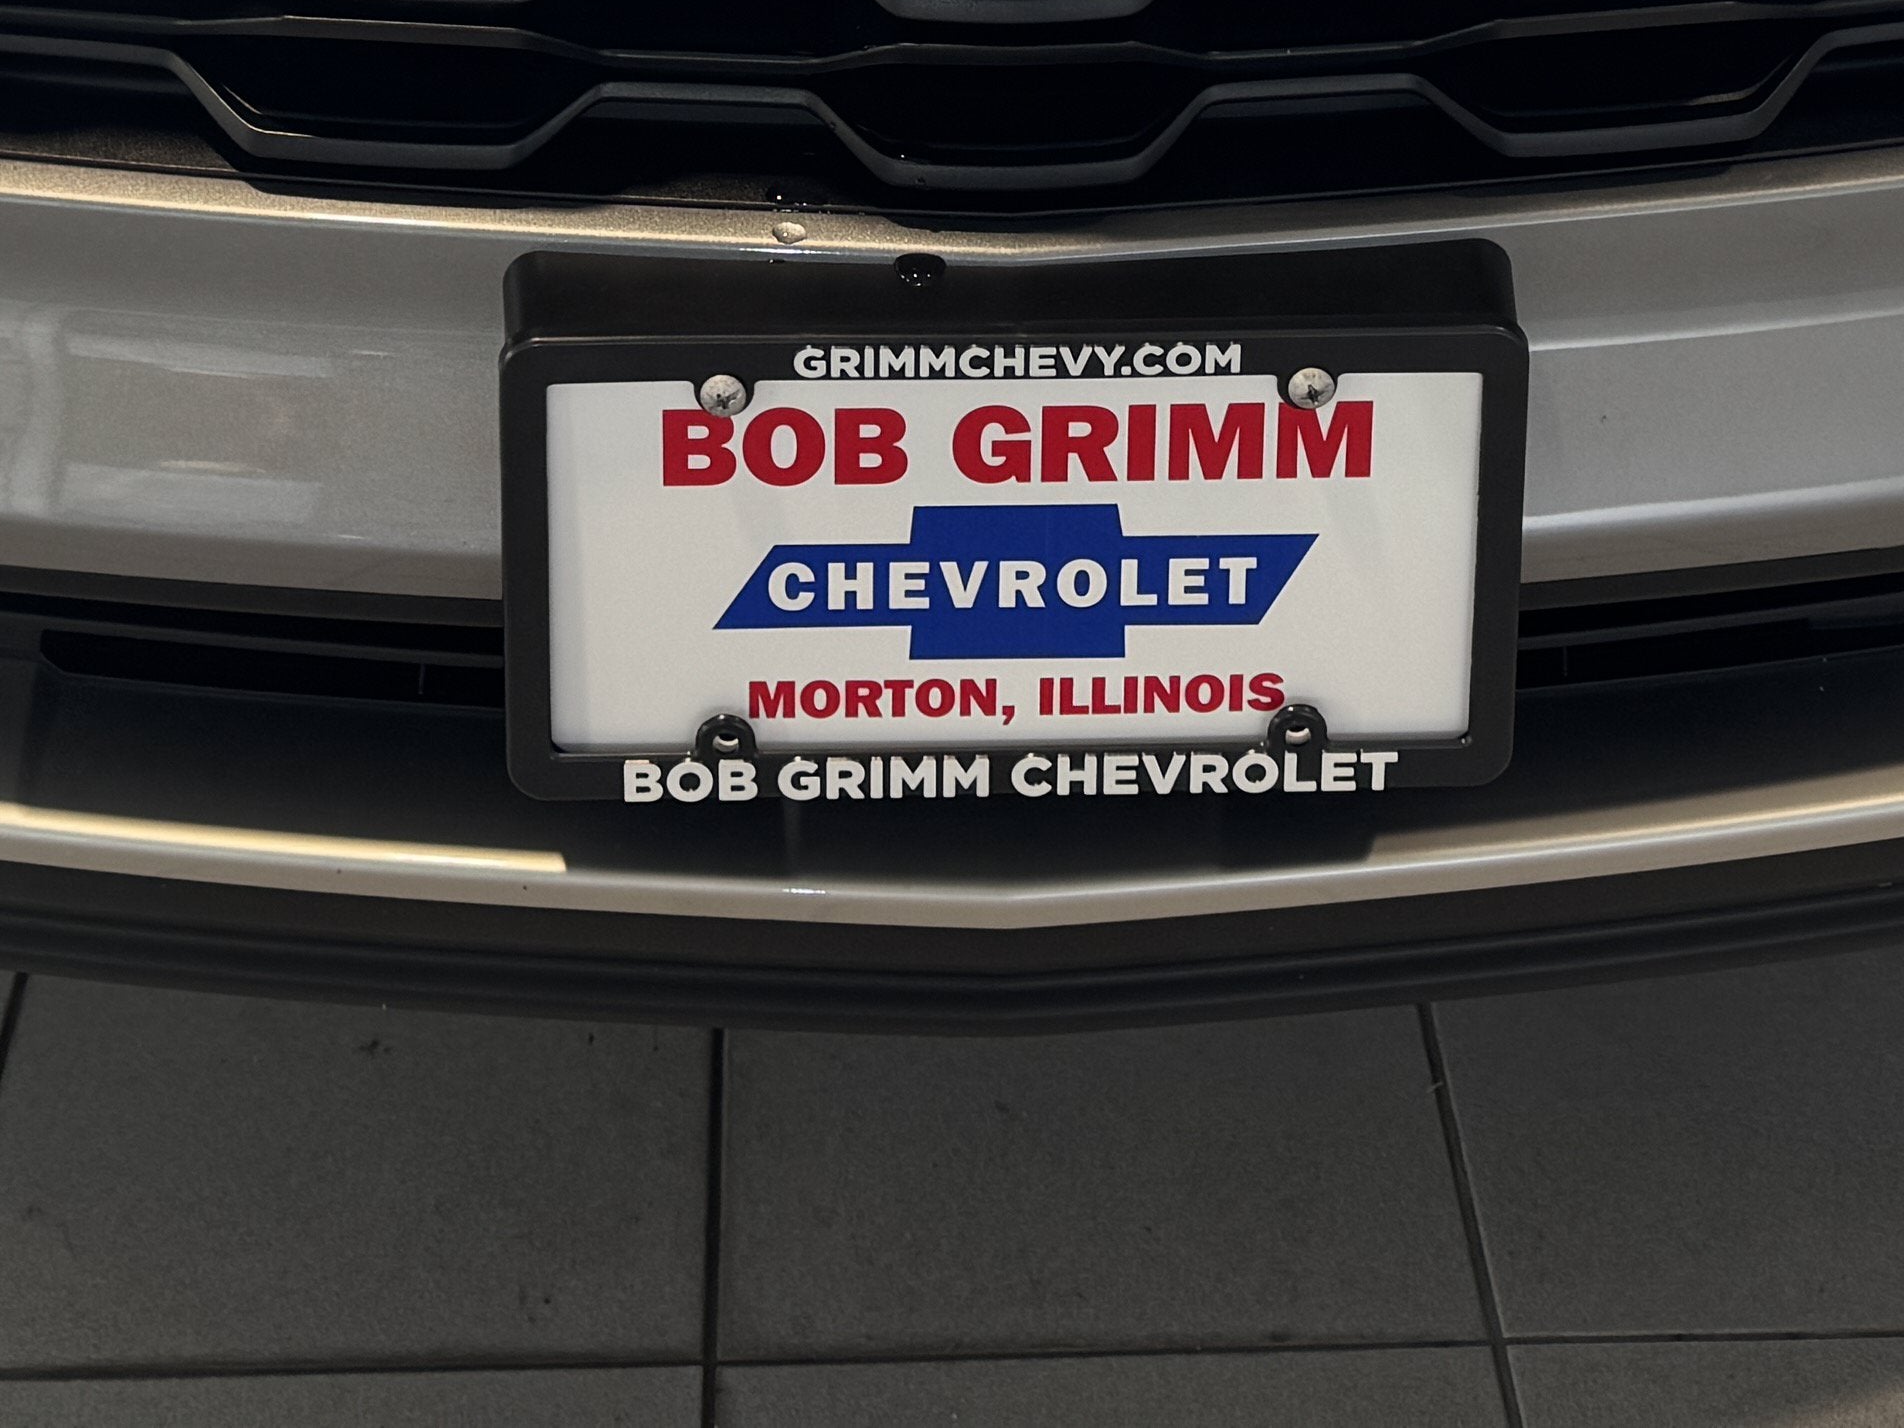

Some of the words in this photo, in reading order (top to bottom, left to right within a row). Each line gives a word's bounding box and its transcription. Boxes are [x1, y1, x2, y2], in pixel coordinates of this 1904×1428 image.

[793, 343, 1242, 379] GRIMMCHEVY.COM
[662, 407, 908, 487] BOB
[952, 400, 1374, 484] GRIMM
[767, 557, 1258, 611] CHEVROLET
[748, 678, 1015, 724] MORTON,
[1038, 673, 1285, 715] ILLINOIS
[623, 758, 759, 803] BOB
[778, 756, 991, 800] GRIMM
[1011, 751, 1400, 796] CHEVROLET
